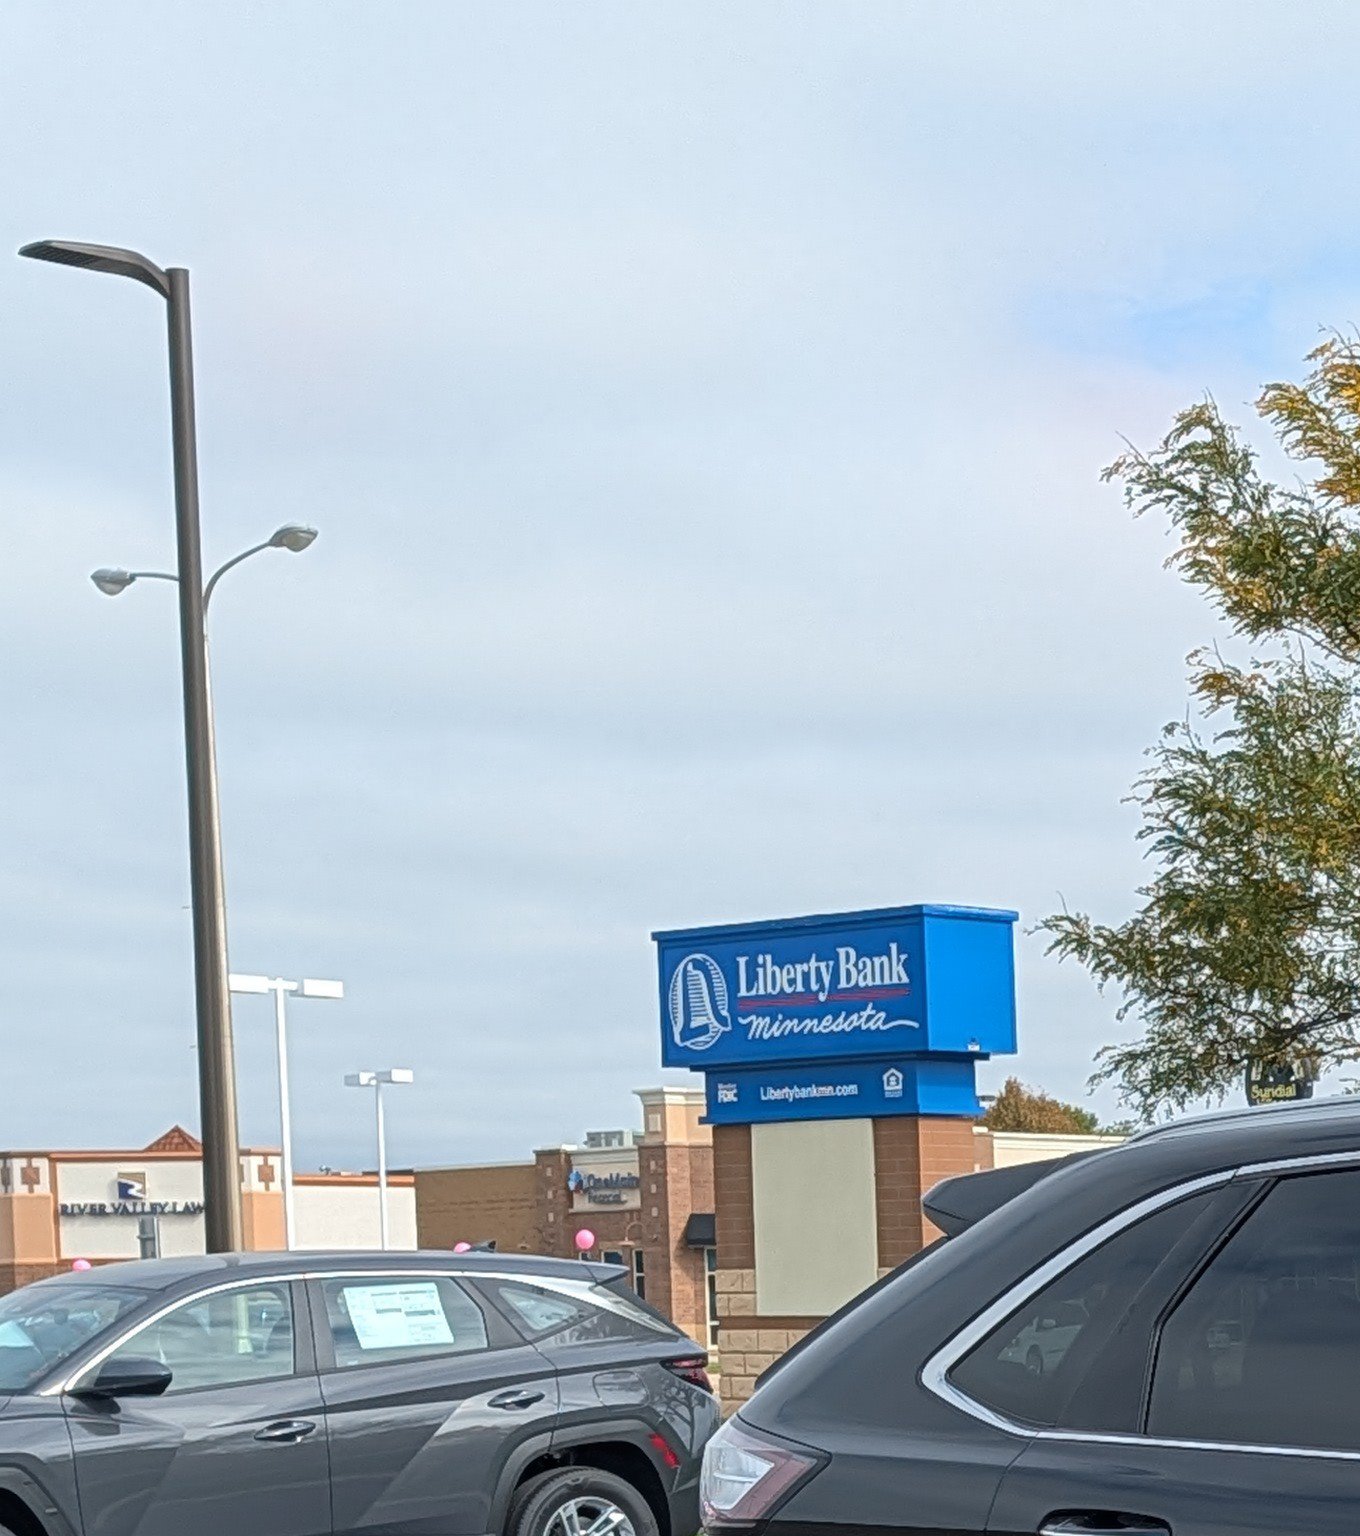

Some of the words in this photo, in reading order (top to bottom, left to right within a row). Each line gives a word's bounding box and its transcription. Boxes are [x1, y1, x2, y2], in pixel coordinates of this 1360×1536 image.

[737, 952, 834, 1002] Liberty
[837, 942, 910, 990] Bank
[60, 1203, 109, 1216] RIVER
[111, 1202, 169, 1215] VALLEY
[172, 1202, 206, 1215] LAW
